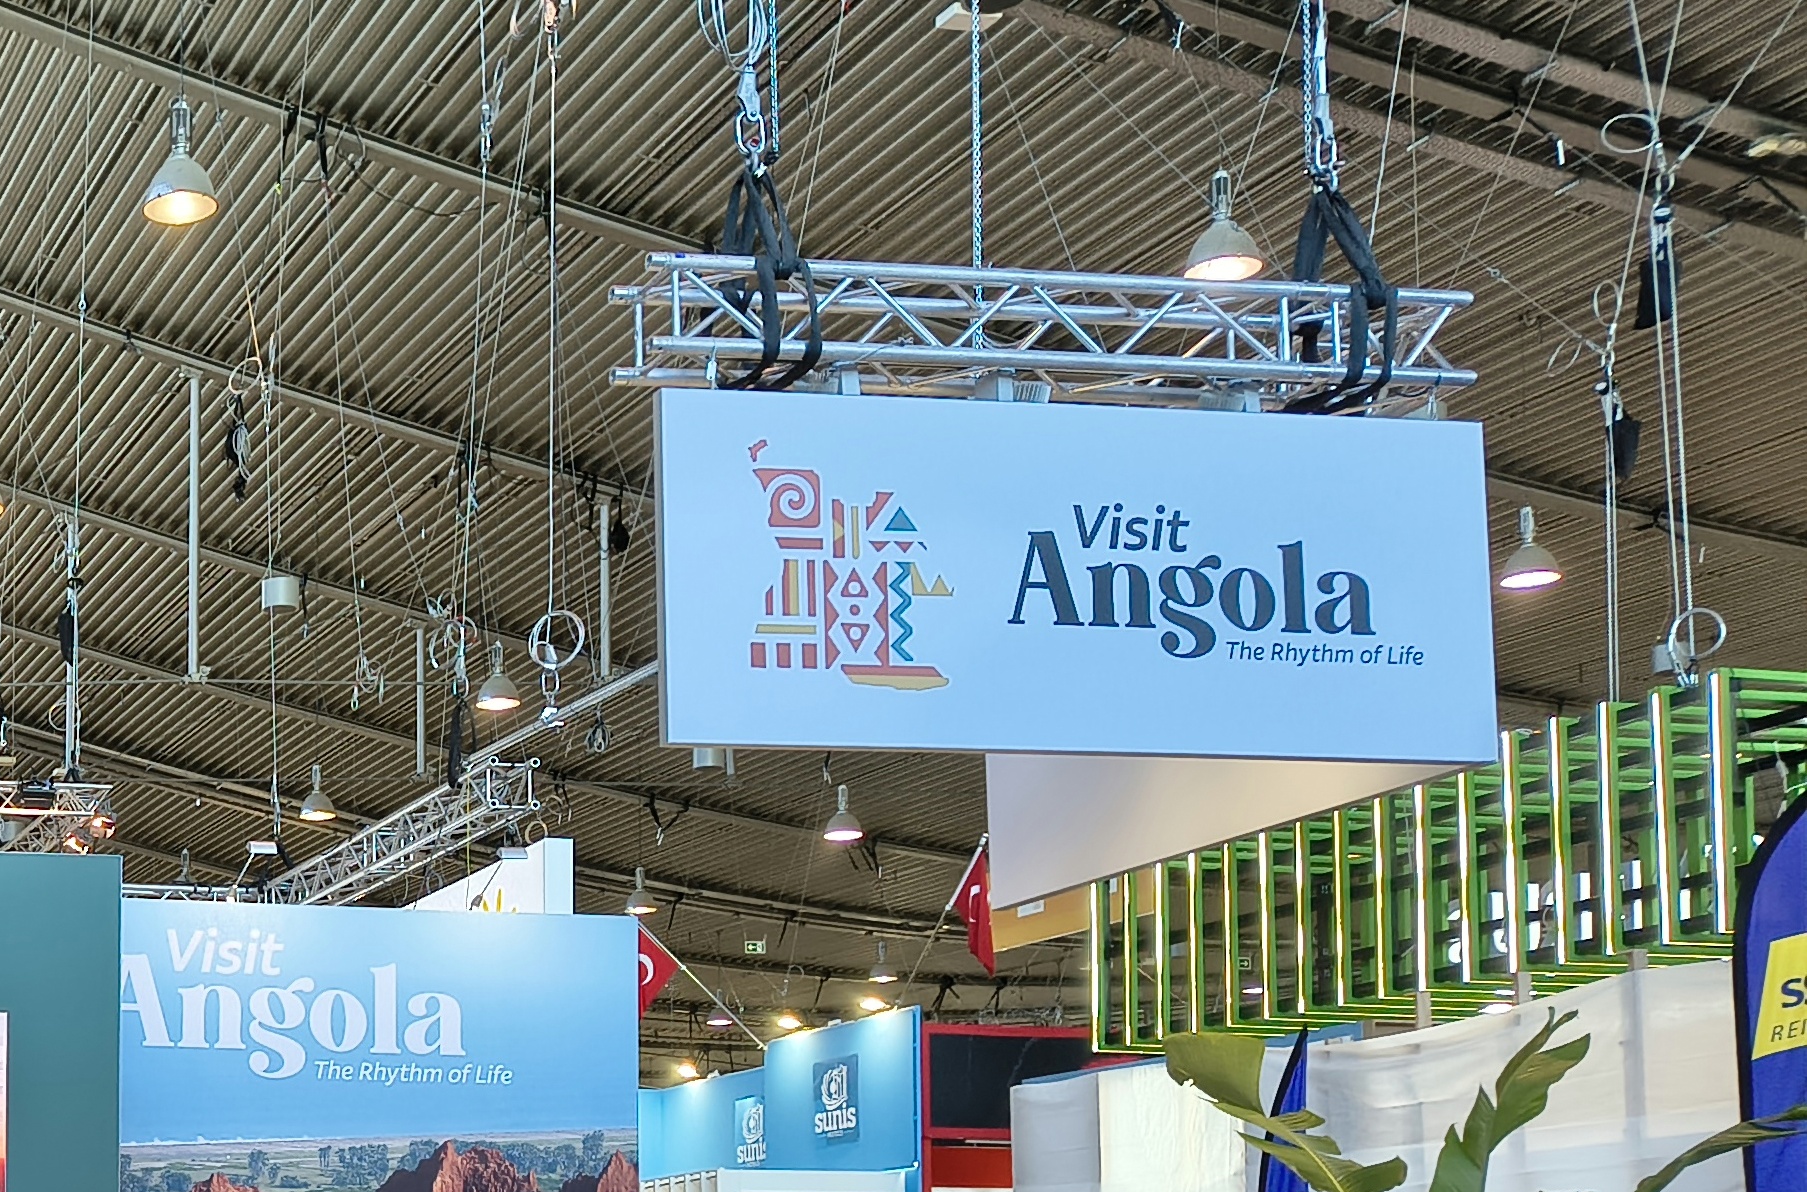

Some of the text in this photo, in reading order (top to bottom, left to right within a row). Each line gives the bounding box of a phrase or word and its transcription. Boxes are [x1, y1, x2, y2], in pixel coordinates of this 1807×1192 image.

[1073, 503, 1190, 553] Visit
[1007, 530, 1377, 659] Angola
[1226, 641, 1425, 667] The Rhythm of Life
[166, 926, 284, 977] Visit
[1780, 977, 1807, 1009] S
[119, 953, 467, 1080] Angola
[314, 1060, 514, 1087] The Rhythm of Life
[814, 1102, 857, 1135] sunis
